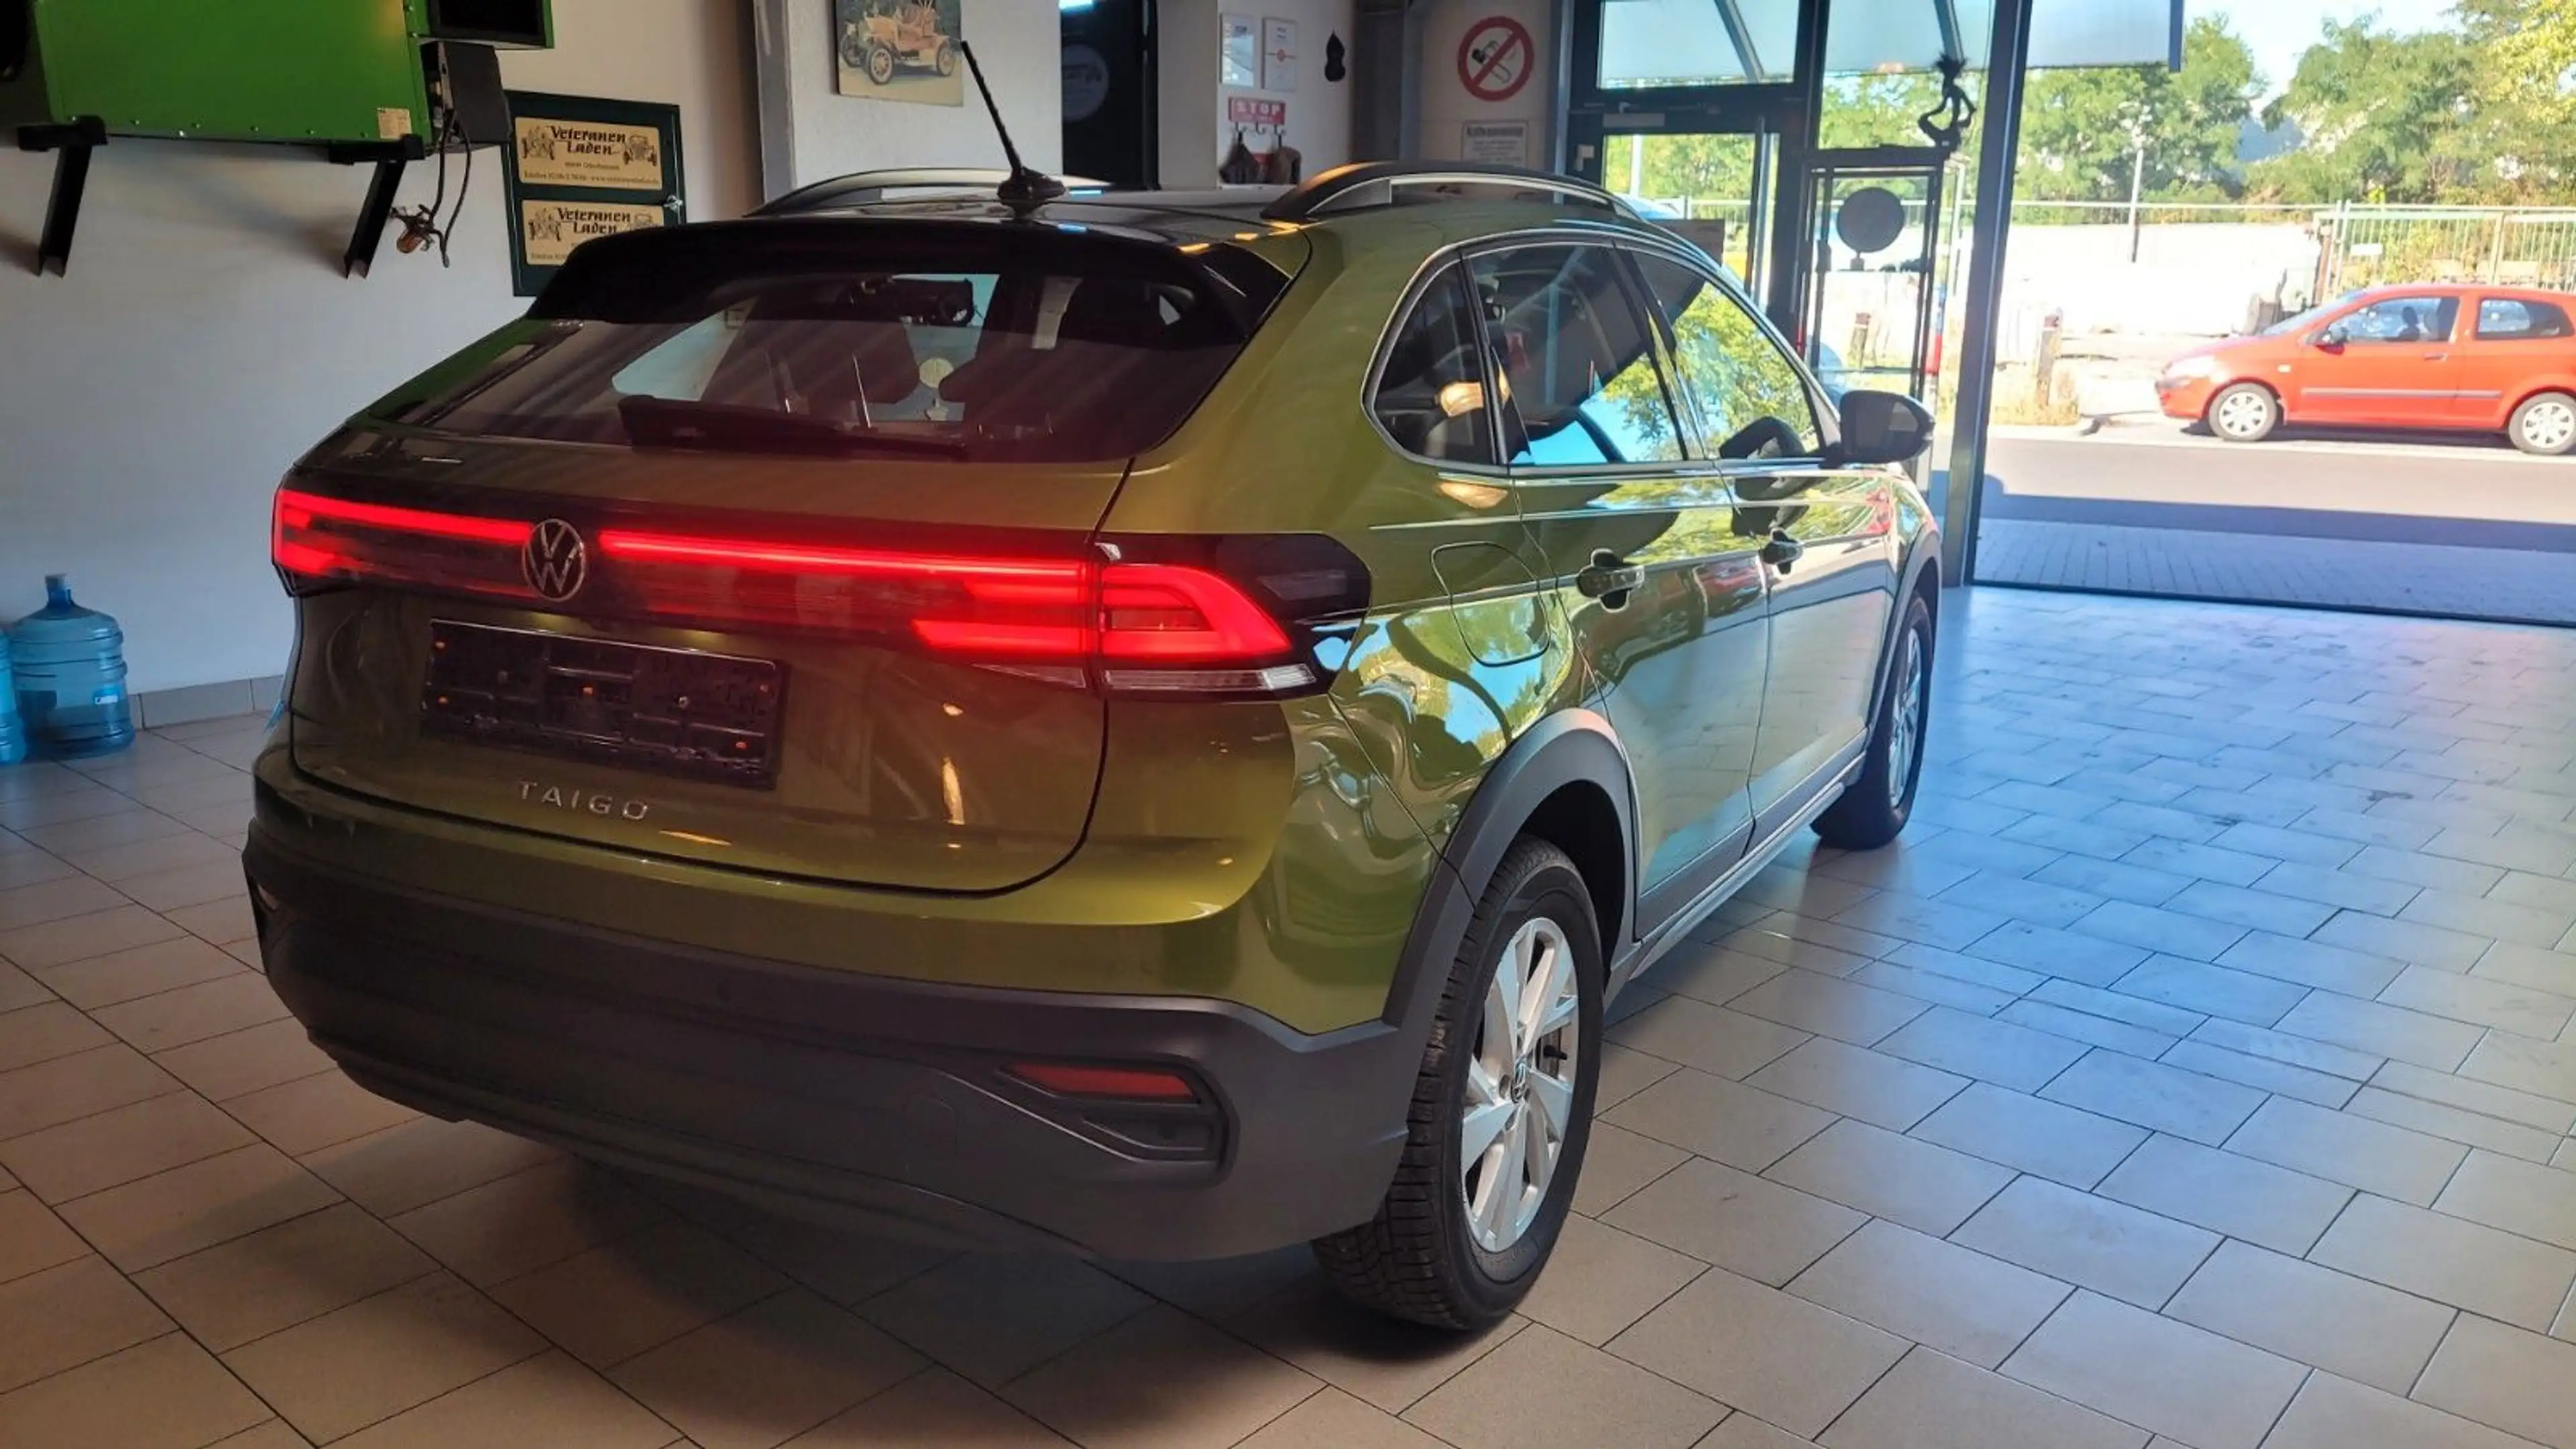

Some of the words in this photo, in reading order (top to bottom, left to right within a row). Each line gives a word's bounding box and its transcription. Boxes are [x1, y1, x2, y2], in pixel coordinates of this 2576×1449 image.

[566, 141, 613, 155] Laden
[572, 221, 618, 234] Laden
[518, 780, 650, 822] TAIGO
